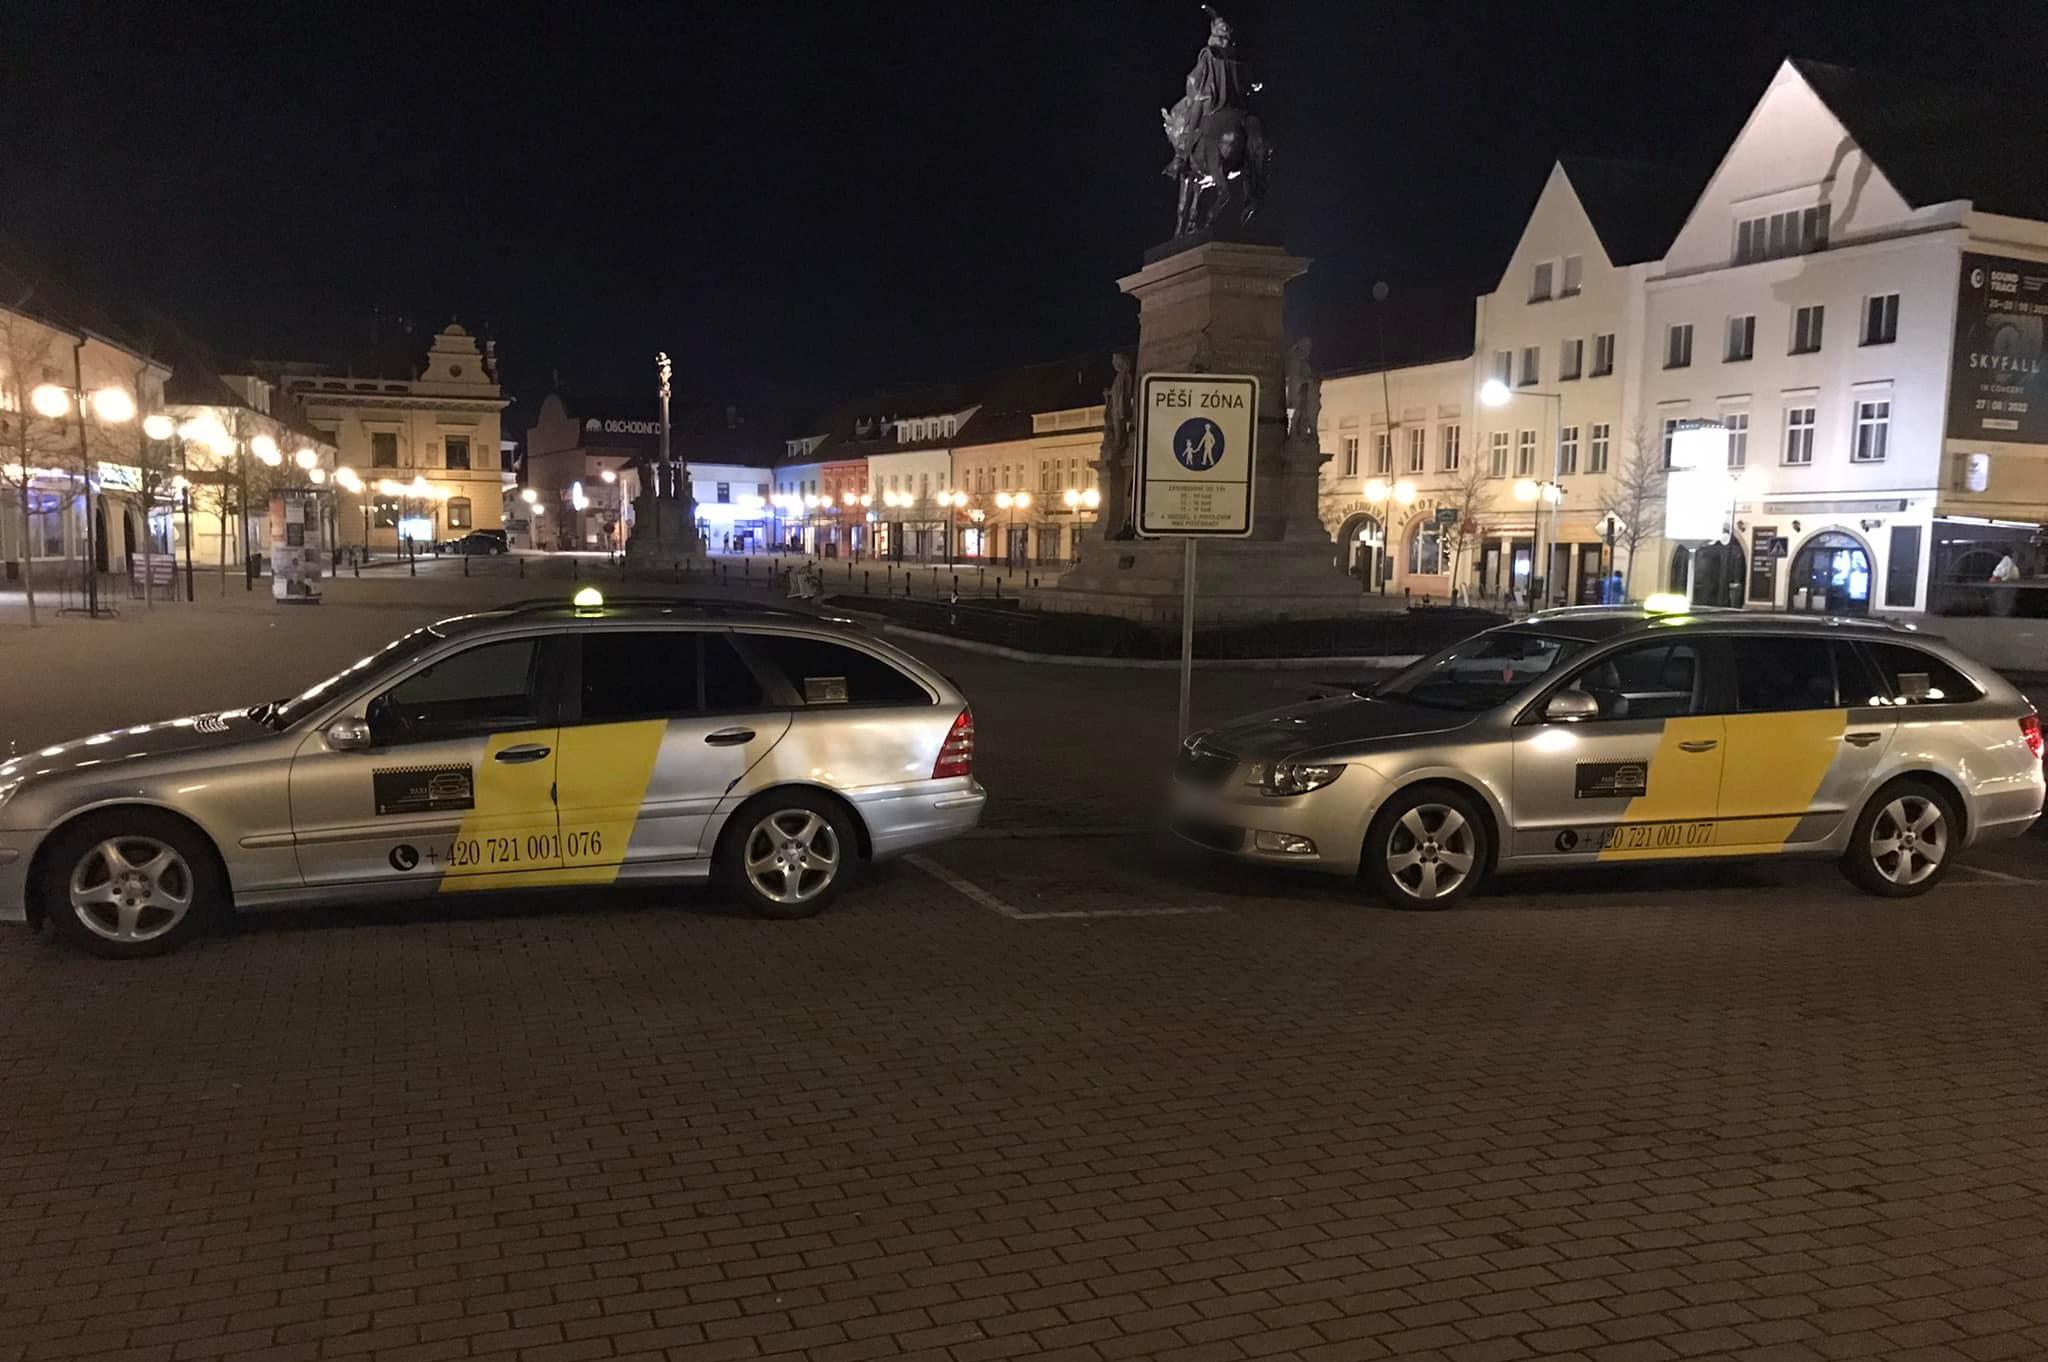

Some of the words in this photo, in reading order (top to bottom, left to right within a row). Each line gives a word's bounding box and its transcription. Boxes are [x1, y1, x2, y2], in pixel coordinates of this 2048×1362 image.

[1969, 353, 2040, 374] SKYFALL
[1156, 389, 1192, 407] PĚŠÍ
[1200, 390, 1244, 409] ZÓNA
[604, 419, 655, 434] OBCHODNÍ
[1596, 827, 1624, 849] 420
[1629, 827, 1652, 848] 721
[1657, 825, 1683, 845] 001
[1686, 824, 1713, 844] 077
[447, 839, 481, 867] 420
[487, 838, 520, 863] 721
[527, 834, 561, 860] 001
[567, 831, 601, 857] 076
